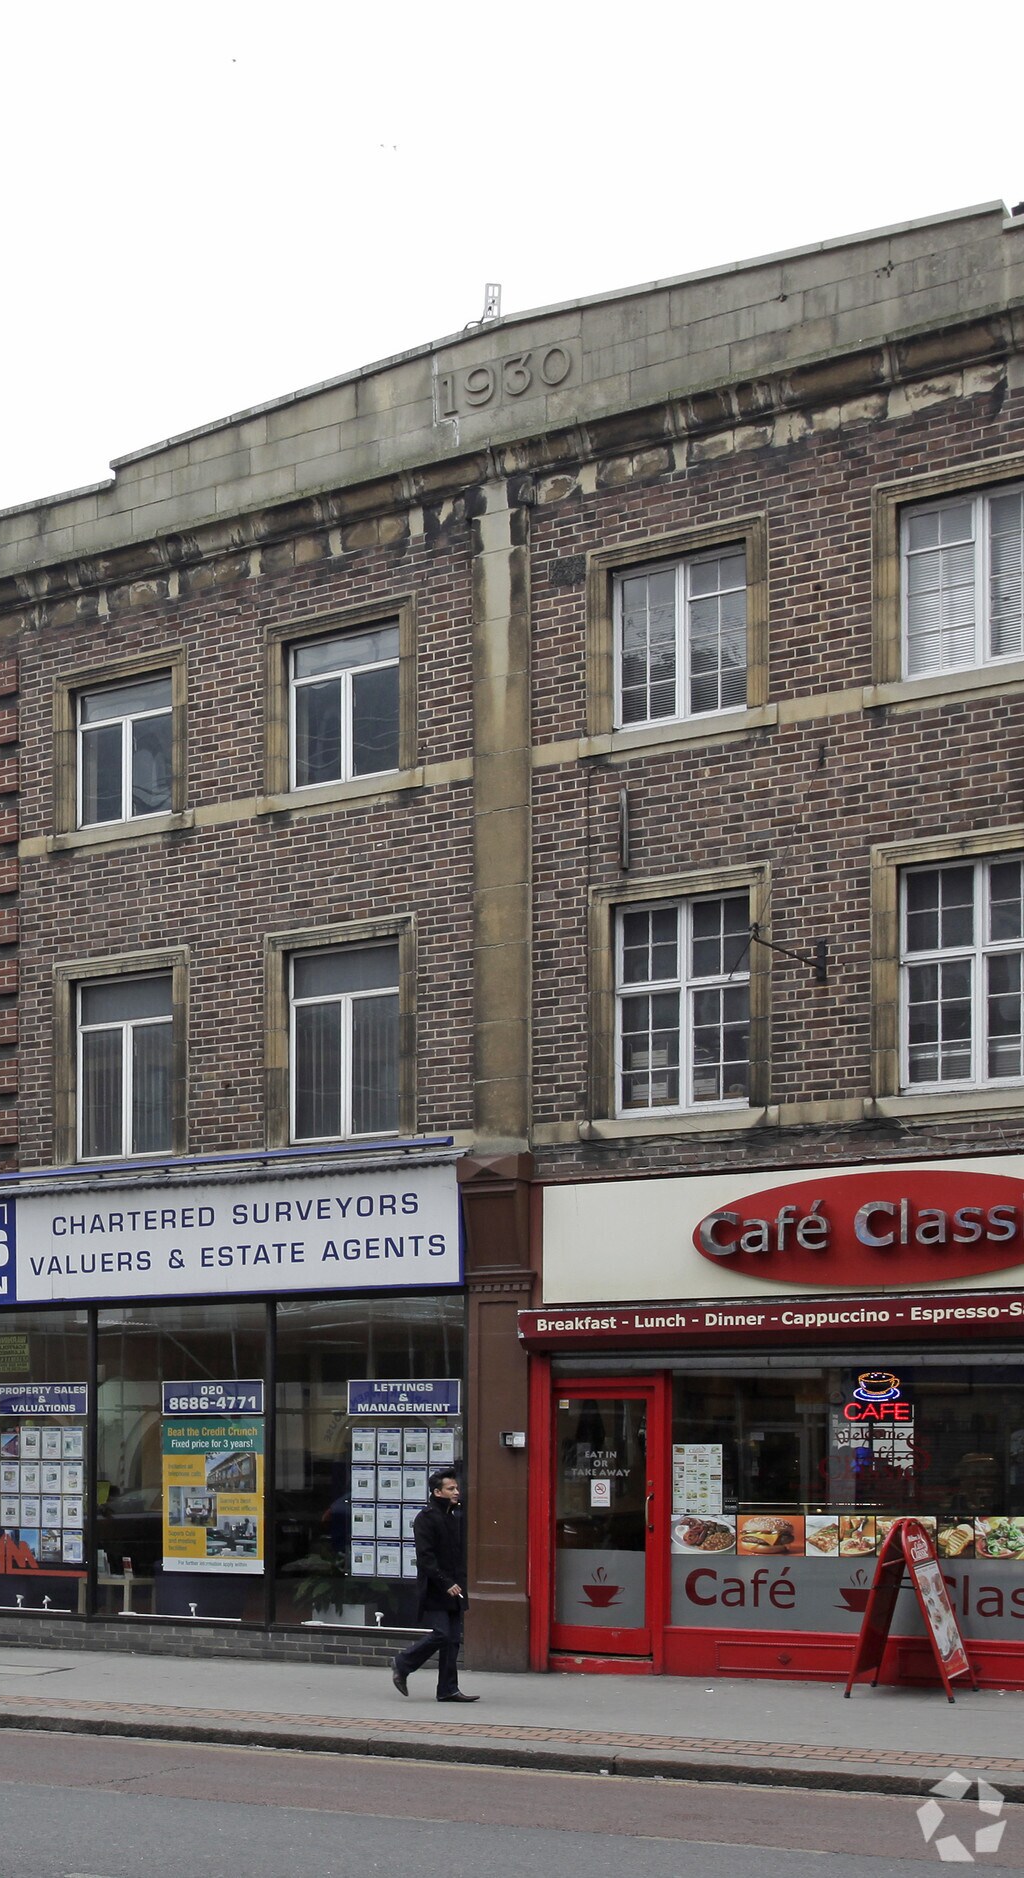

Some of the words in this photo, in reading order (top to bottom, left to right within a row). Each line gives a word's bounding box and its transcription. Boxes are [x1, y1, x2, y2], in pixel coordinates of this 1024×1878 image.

[443, 348, 571, 417] 1930
[52, 1207, 216, 1236] CHARTERED
[232, 1193, 420, 1225] SURVEYORS
[699, 1200, 831, 1256] Café
[854, 1197, 1024, 1247] Class
[30, 1250, 152, 1276] VALUERS
[168, 1249, 186, 1269] &
[200, 1242, 305, 1268] ESTATE
[322, 1234, 447, 1261] AGENTS
[536, 1316, 617, 1332] Breakfast
[634, 1313, 686, 1329] Lunch
[705, 1312, 765, 1328] Dinner
[781, 1308, 890, 1327] Cappuccino
[0, 1386, 51, 1395] PROPERTY
[54, 1386, 86, 1394] SALES
[200, 1385, 224, 1395] 020
[374, 1383, 433, 1392] LETTINGS
[38, 1395, 46, 1404] &
[398, 1393, 409, 1402] &
[11, 1404, 76, 1412] VALUATIONS
[169, 1396, 256, 1410] 8686-4771
[357, 1403, 450, 1412] MANAGEMENT
[843, 1402, 911, 1421] CAFE
[167, 1427, 185, 1437] Beat
[187, 1427, 199, 1436] the
[201, 1427, 226, 1436] Credit
[228, 1426, 258, 1436] Crunch
[171, 1439, 190, 1448] Fixed
[191, 1440, 209, 1449] price
[211, 1440, 221, 1448] for
[223, 1440, 229, 1448] 3
[230, 1439, 253, 1449] years!
[584, 1451, 602, 1459] EAT
[605, 1451, 617, 1459] IN
[593, 1459, 608, 1468] OR
[571, 1468, 597, 1477] TAKE
[599, 1468, 631, 1477] AWAY
[684, 1566, 796, 1609] Café
